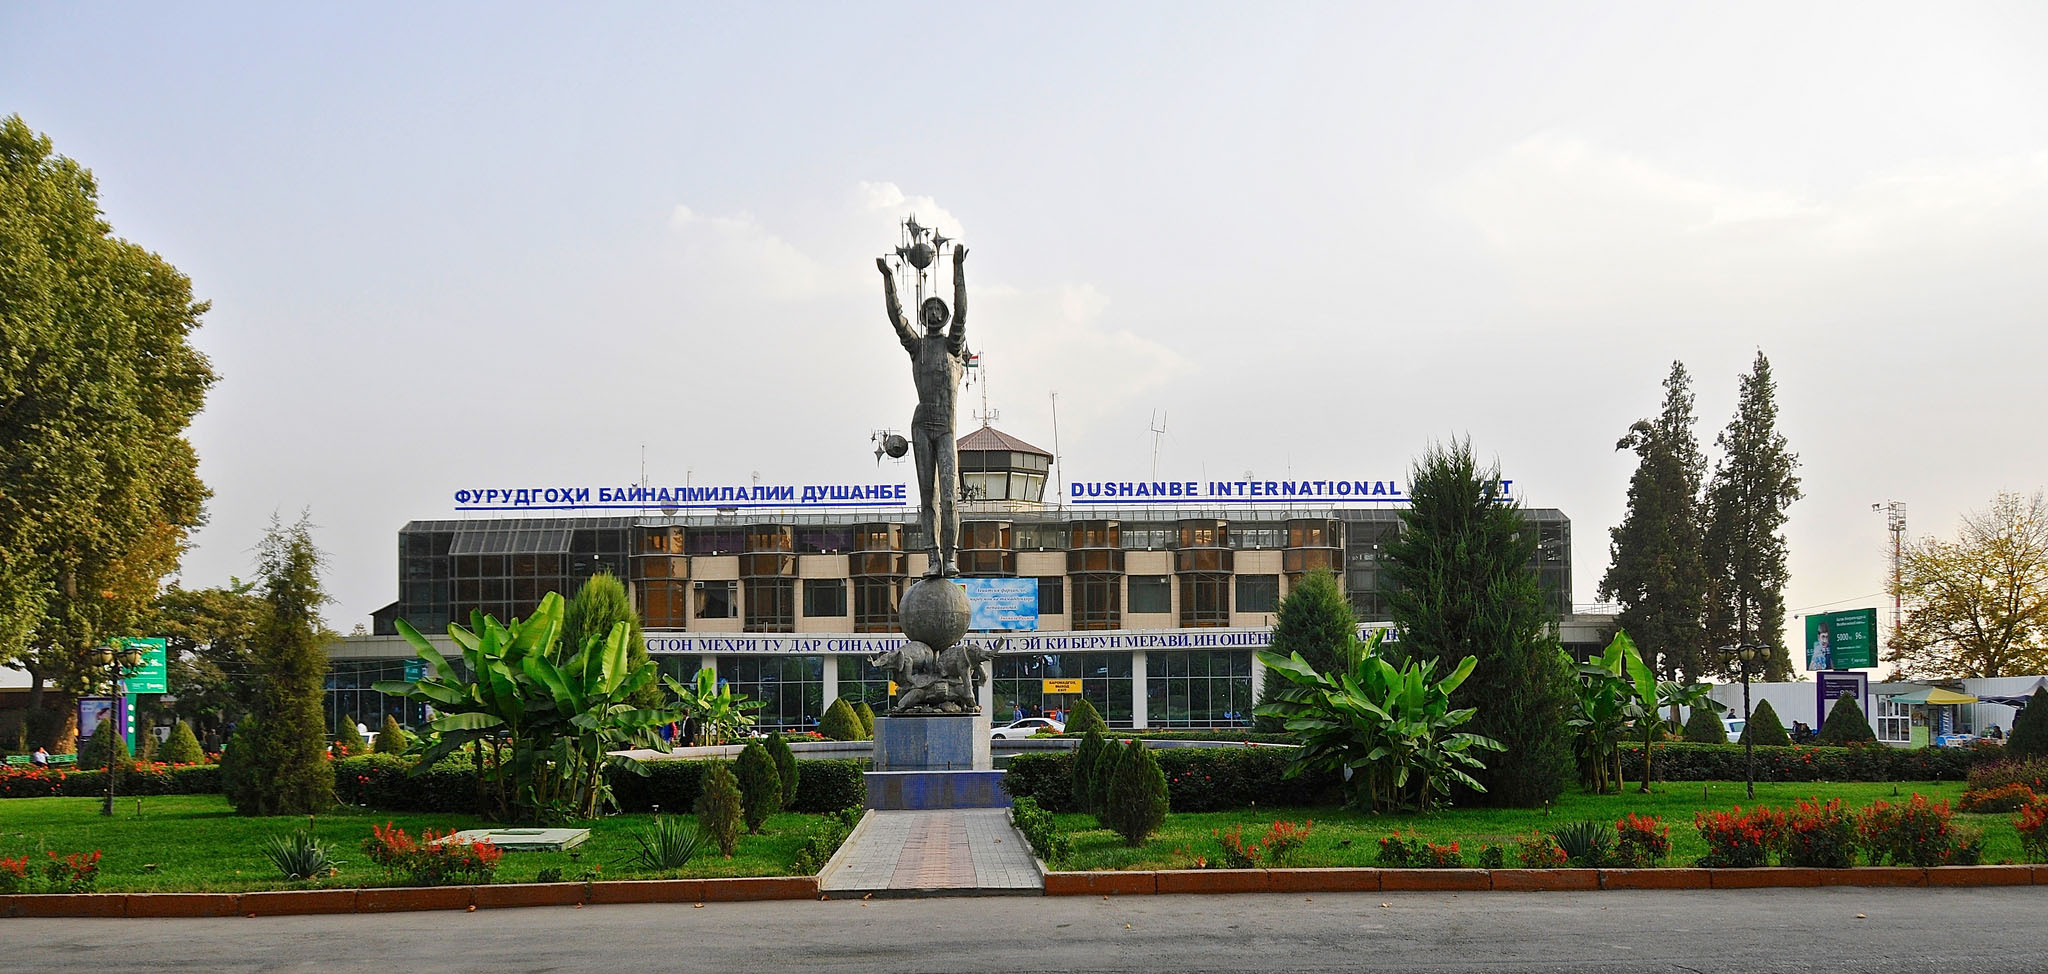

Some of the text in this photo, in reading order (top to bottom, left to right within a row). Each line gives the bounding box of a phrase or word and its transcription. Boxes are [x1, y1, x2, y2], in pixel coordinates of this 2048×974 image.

[455, 484, 907, 505] ФУРУДГОҲИ БАЙНАЛМИЛАЛИИ ДУШАНБЕ
[1071, 481, 1198, 497] DUSHANBE
[1209, 480, 1401, 496] INTERNATIONAL
[699, 639, 757, 653] МЕҲРИ
[761, 639, 784, 651] ТУ
[789, 639, 821, 653] ДАР
[1019, 636, 1041, 650] ЭЙ
[1046, 638, 1067, 650] КИ
[1071, 637, 1121, 650] БЕРУН
[1193, 634, 1217, 646] ИН
